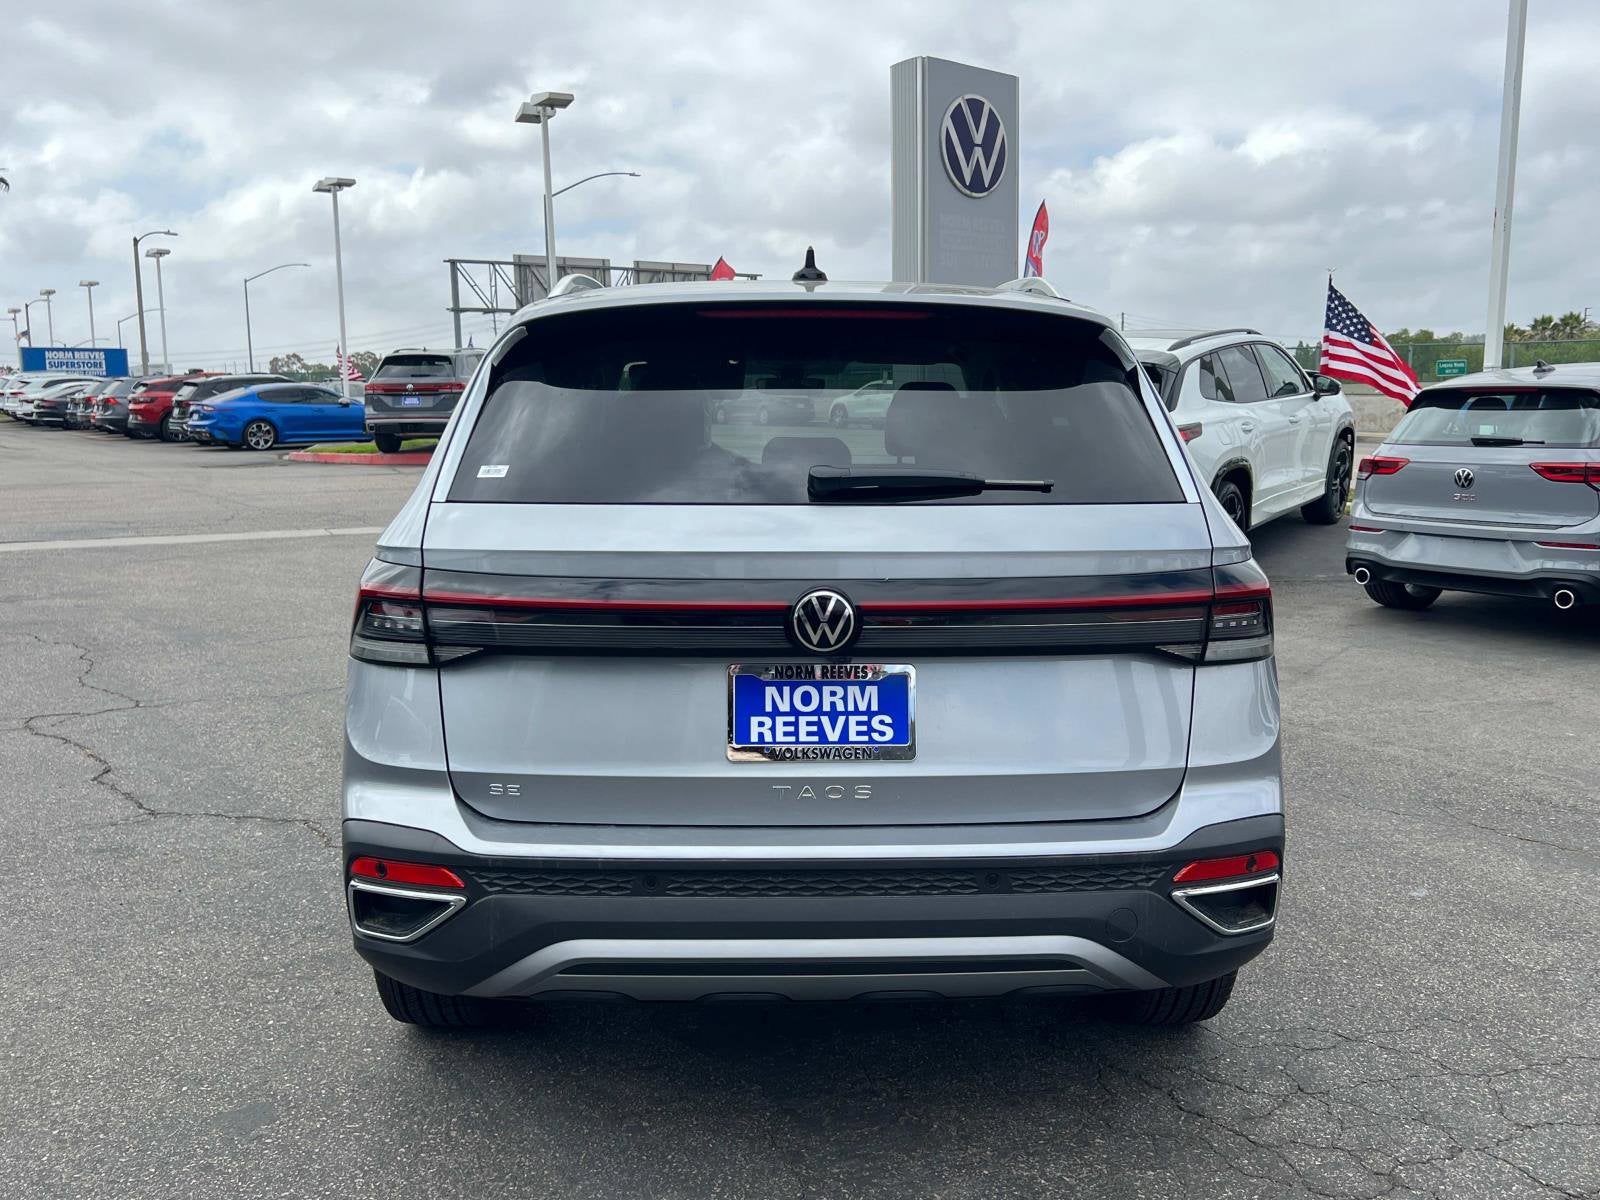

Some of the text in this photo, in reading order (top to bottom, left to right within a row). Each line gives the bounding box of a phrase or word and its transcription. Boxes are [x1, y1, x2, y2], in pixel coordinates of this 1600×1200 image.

[46, 351, 105, 360] NORM REEVES
[48, 361, 104, 369] SUPERSTORE
[774, 665, 869, 680] NORM REEVES
[765, 686, 879, 712] NORM
[750, 715, 894, 743] REEVES
[773, 747, 873, 760] VOLKSWAGEN
[489, 783, 521, 796] SE
[772, 785, 873, 800] TAOS
